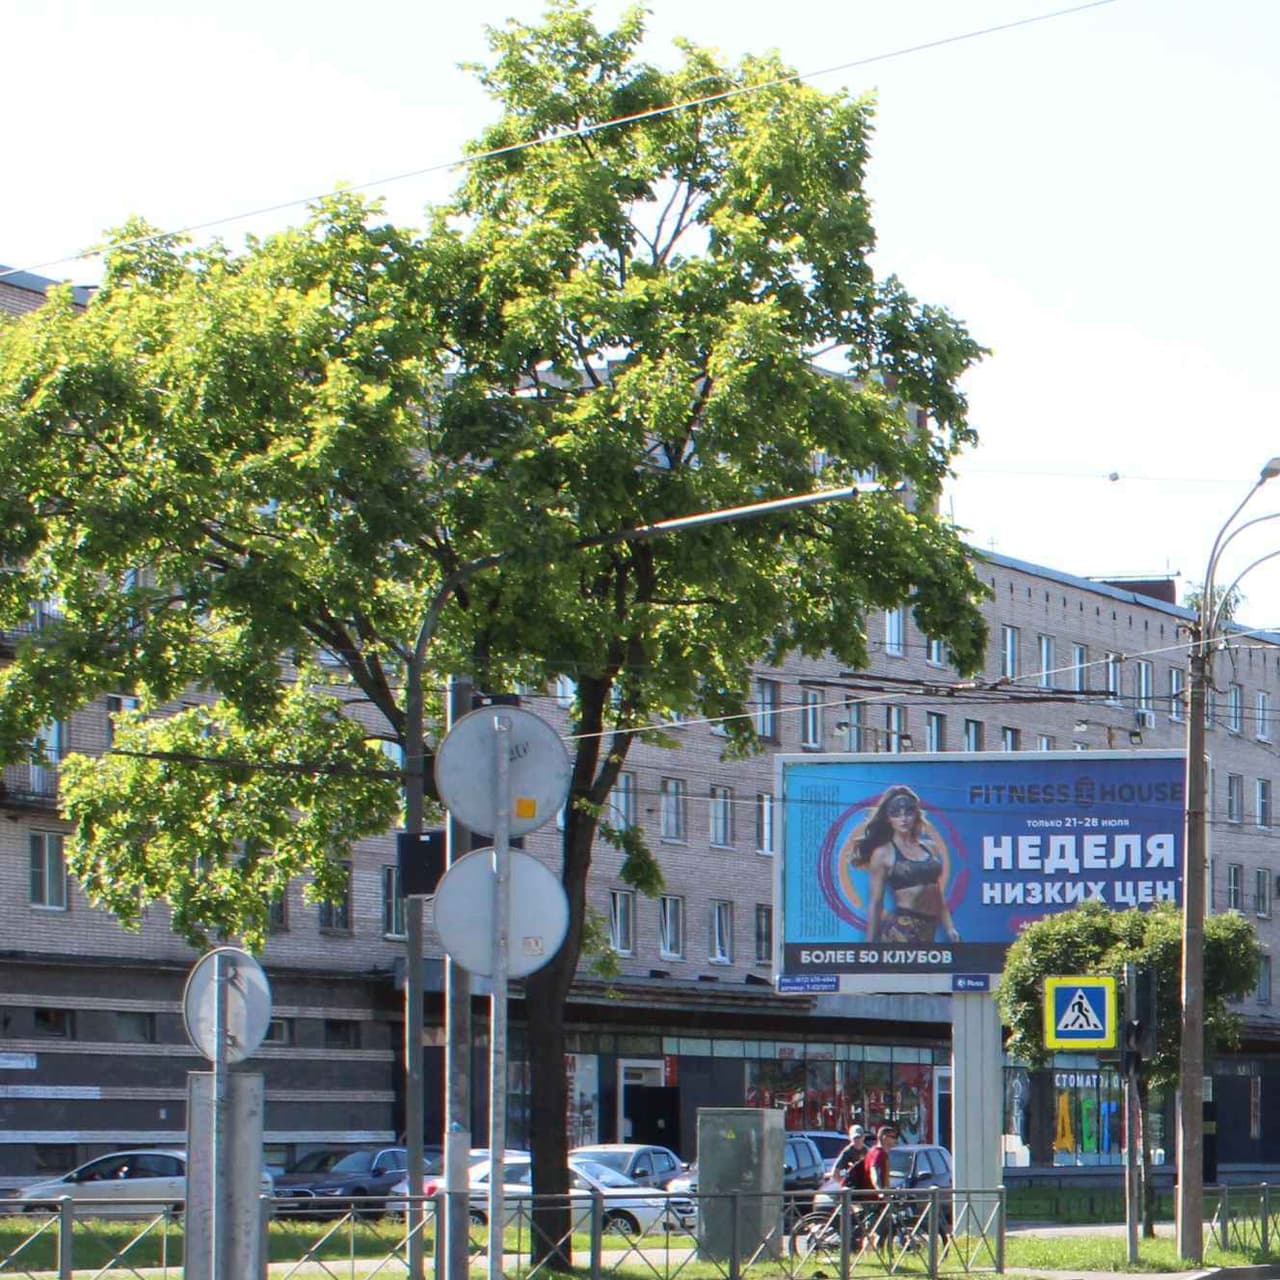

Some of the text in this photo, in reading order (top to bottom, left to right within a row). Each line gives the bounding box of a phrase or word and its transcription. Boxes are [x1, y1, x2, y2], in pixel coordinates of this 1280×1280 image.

[969, 782, 1184, 804] FITNESS HOUSE
[1026, 818, 1062, 828] только
[1101, 818, 1130, 827] июля
[982, 833, 1175, 874] НЕДЕЛЯ
[982, 880, 1106, 904] НИЗКИХ
[801, 950, 953, 964] БОЛЕЕ 50 КЛУБОВ
